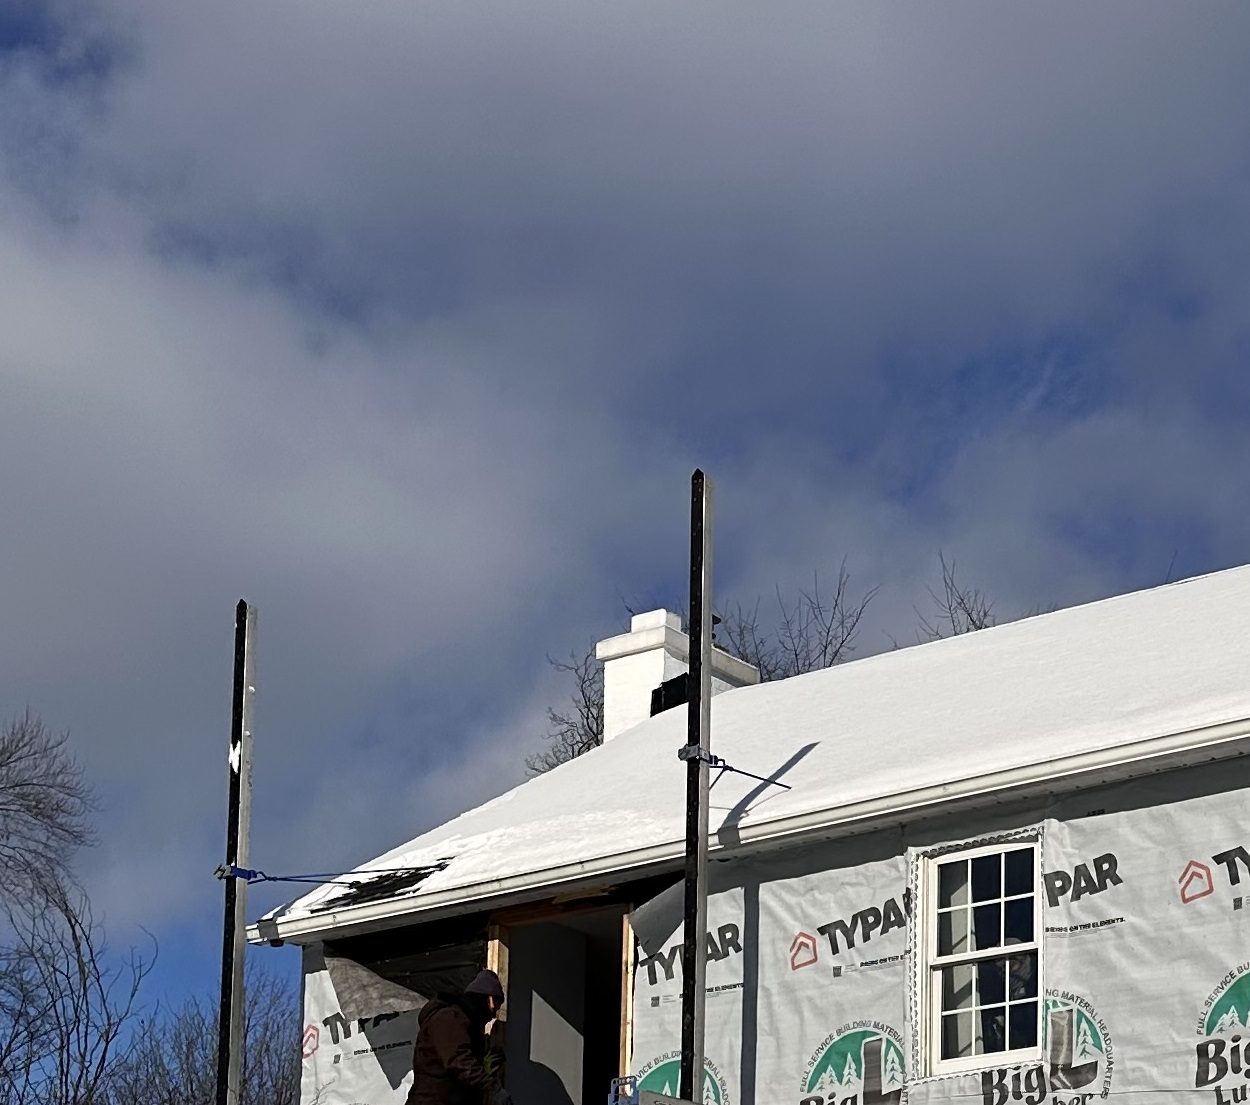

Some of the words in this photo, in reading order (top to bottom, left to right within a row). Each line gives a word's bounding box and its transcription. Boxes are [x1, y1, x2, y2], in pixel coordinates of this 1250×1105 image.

[1043, 853, 1123, 908] PAR
[638, 923, 742, 986] TYAR
[1197, 1011, 1208, 1035] FULL
[1205, 971, 1237, 1008] SERVICE
[808, 1033, 836, 1067] SERVICE
[1061, 990, 1098, 1021] MATERIAL
[1098, 1019, 1115, 1100] HEADQUARTERS
